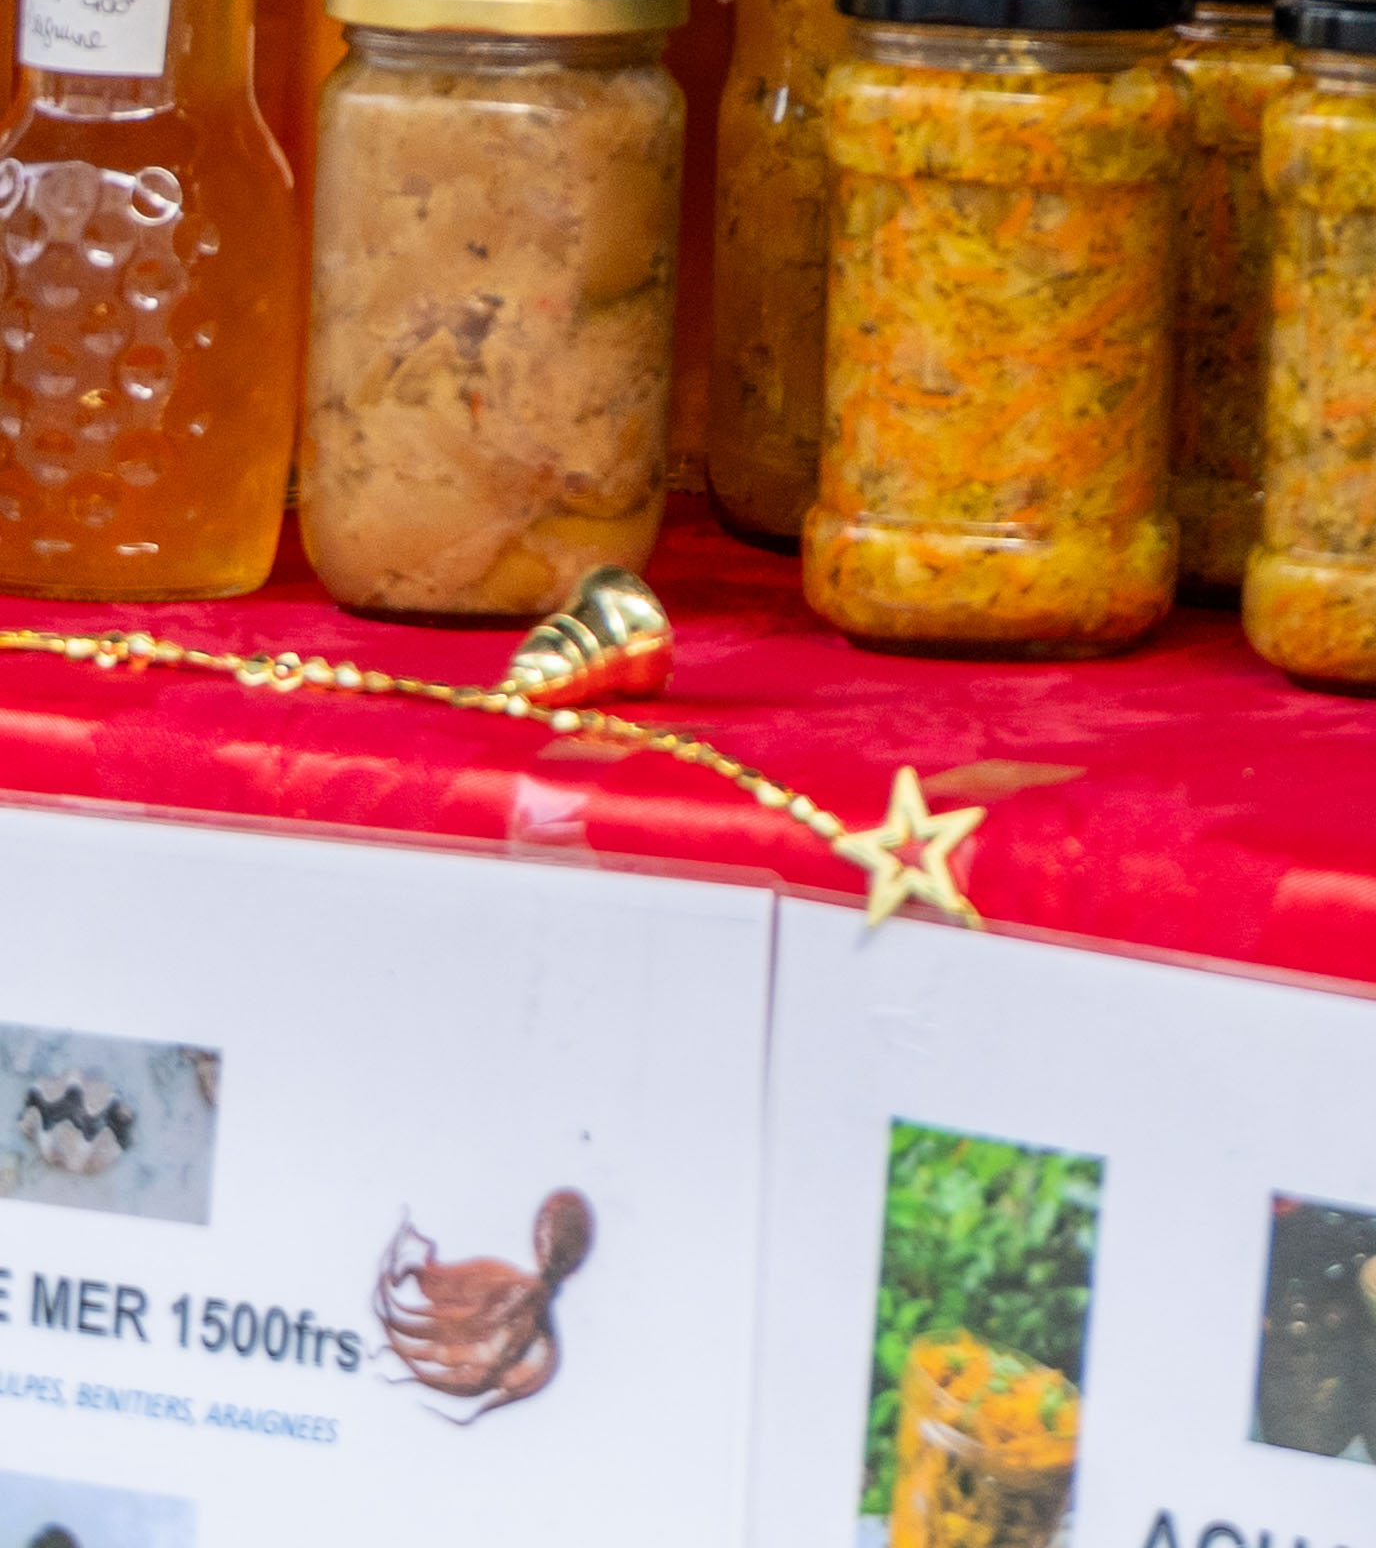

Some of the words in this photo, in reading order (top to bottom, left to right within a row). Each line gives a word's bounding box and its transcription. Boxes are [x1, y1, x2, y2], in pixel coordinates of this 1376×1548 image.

[30, 1270, 149, 1344] MER
[170, 1291, 363, 1373] 1500frs
[204, 1401, 340, 1443] ARAIGNEES
